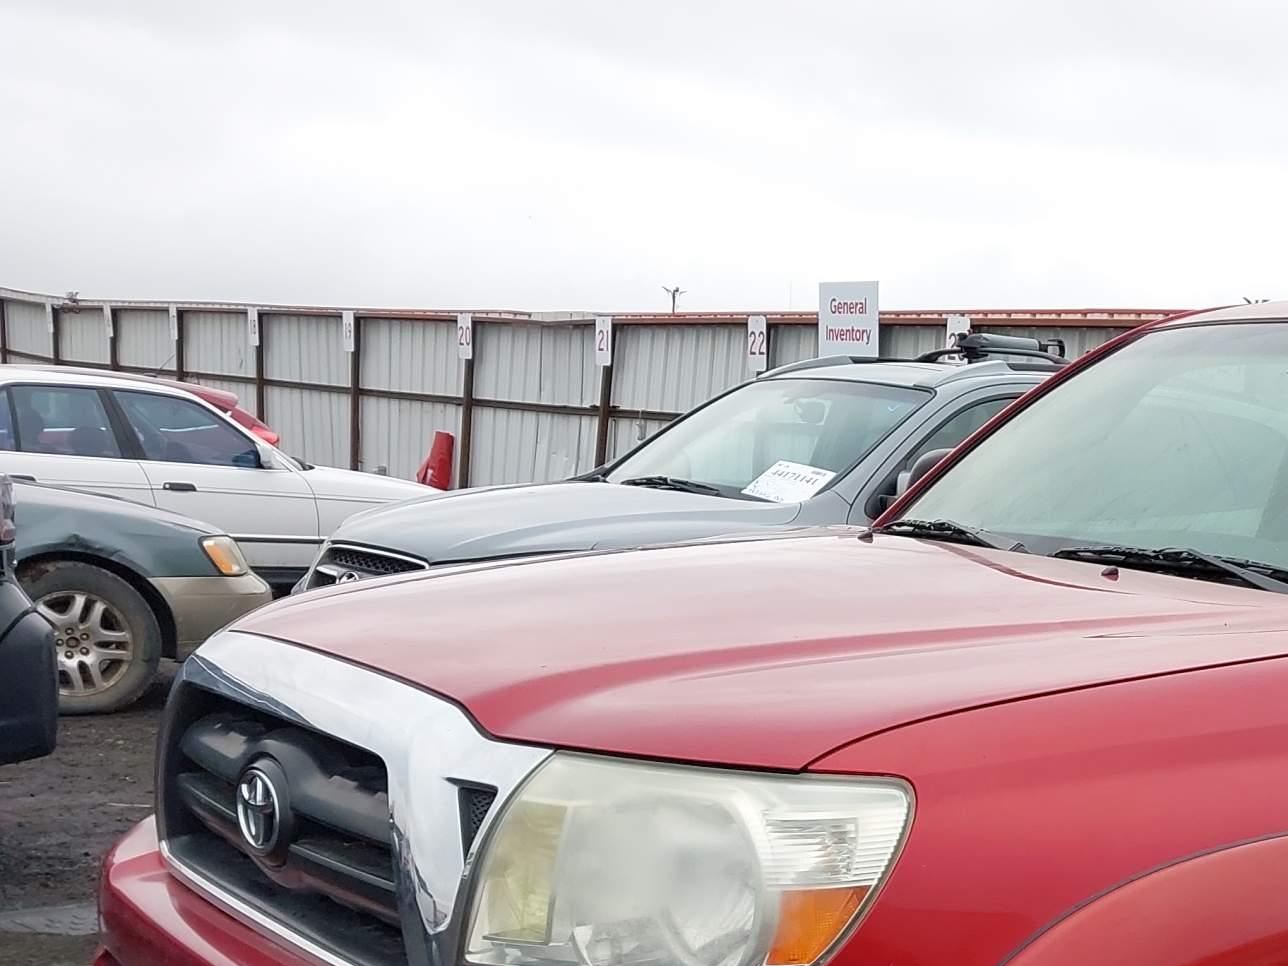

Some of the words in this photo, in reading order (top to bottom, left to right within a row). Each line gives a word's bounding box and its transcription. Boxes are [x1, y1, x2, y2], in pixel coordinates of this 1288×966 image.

[829, 297, 868, 315] General
[458, 326, 471, 346] 20
[597, 329, 610, 352] 21
[748, 330, 766, 356] 22
[825, 325, 872, 345] Inventory
